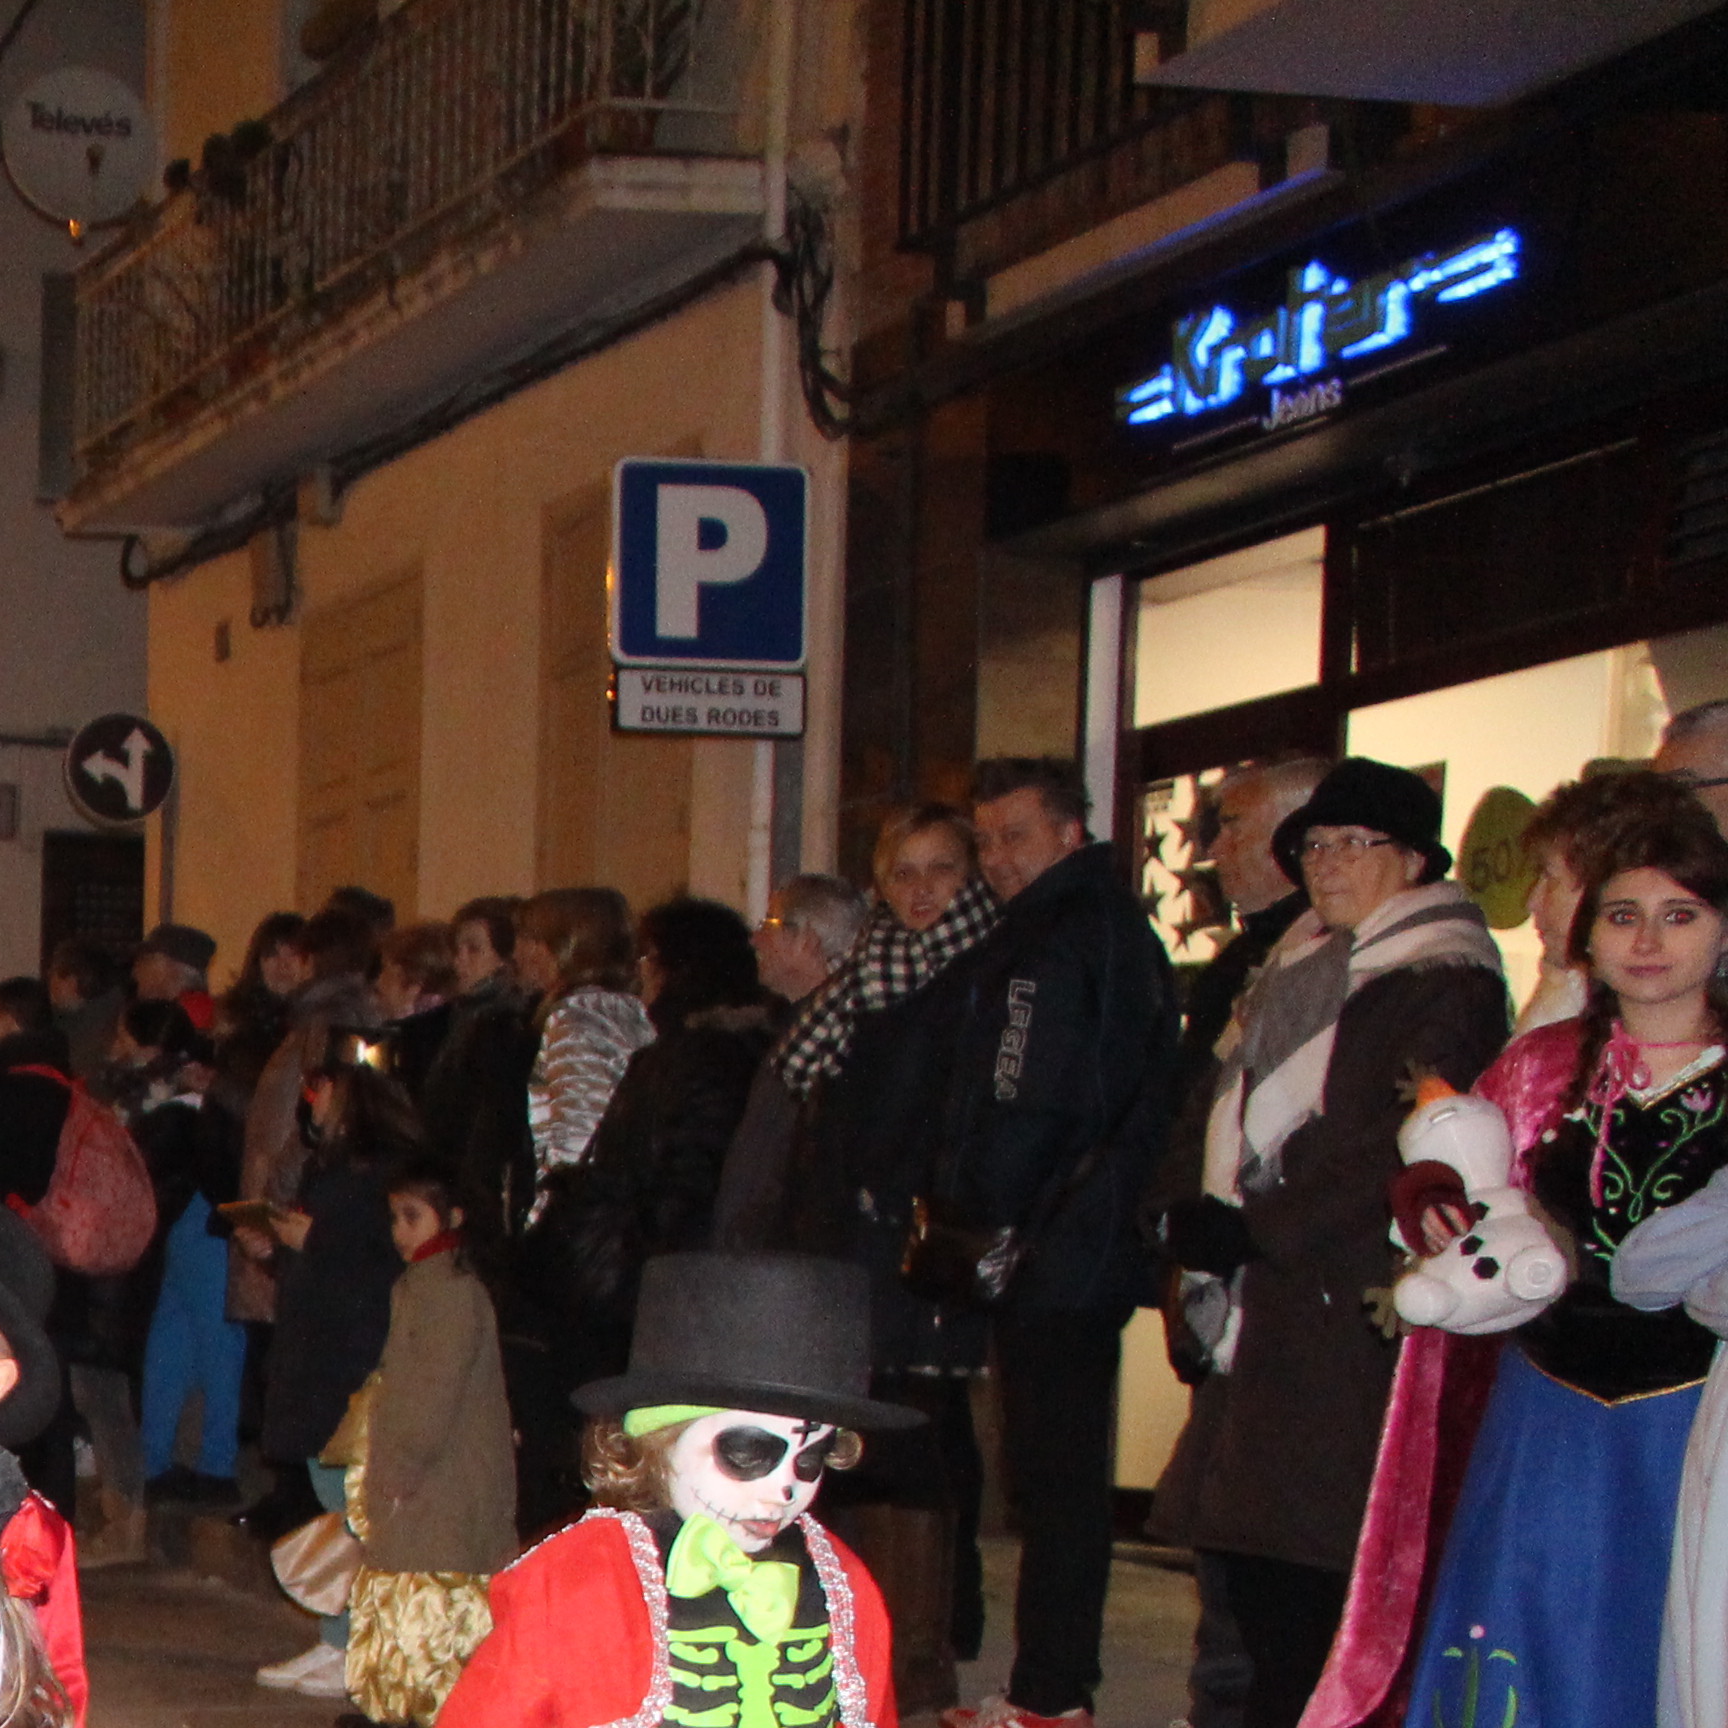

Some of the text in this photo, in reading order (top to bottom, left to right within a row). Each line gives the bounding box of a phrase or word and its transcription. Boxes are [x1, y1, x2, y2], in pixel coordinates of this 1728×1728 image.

[655, 483, 768, 640] P
[640, 675, 782, 698] VEHICLES DE
[641, 705, 780, 728] DUES RODES
